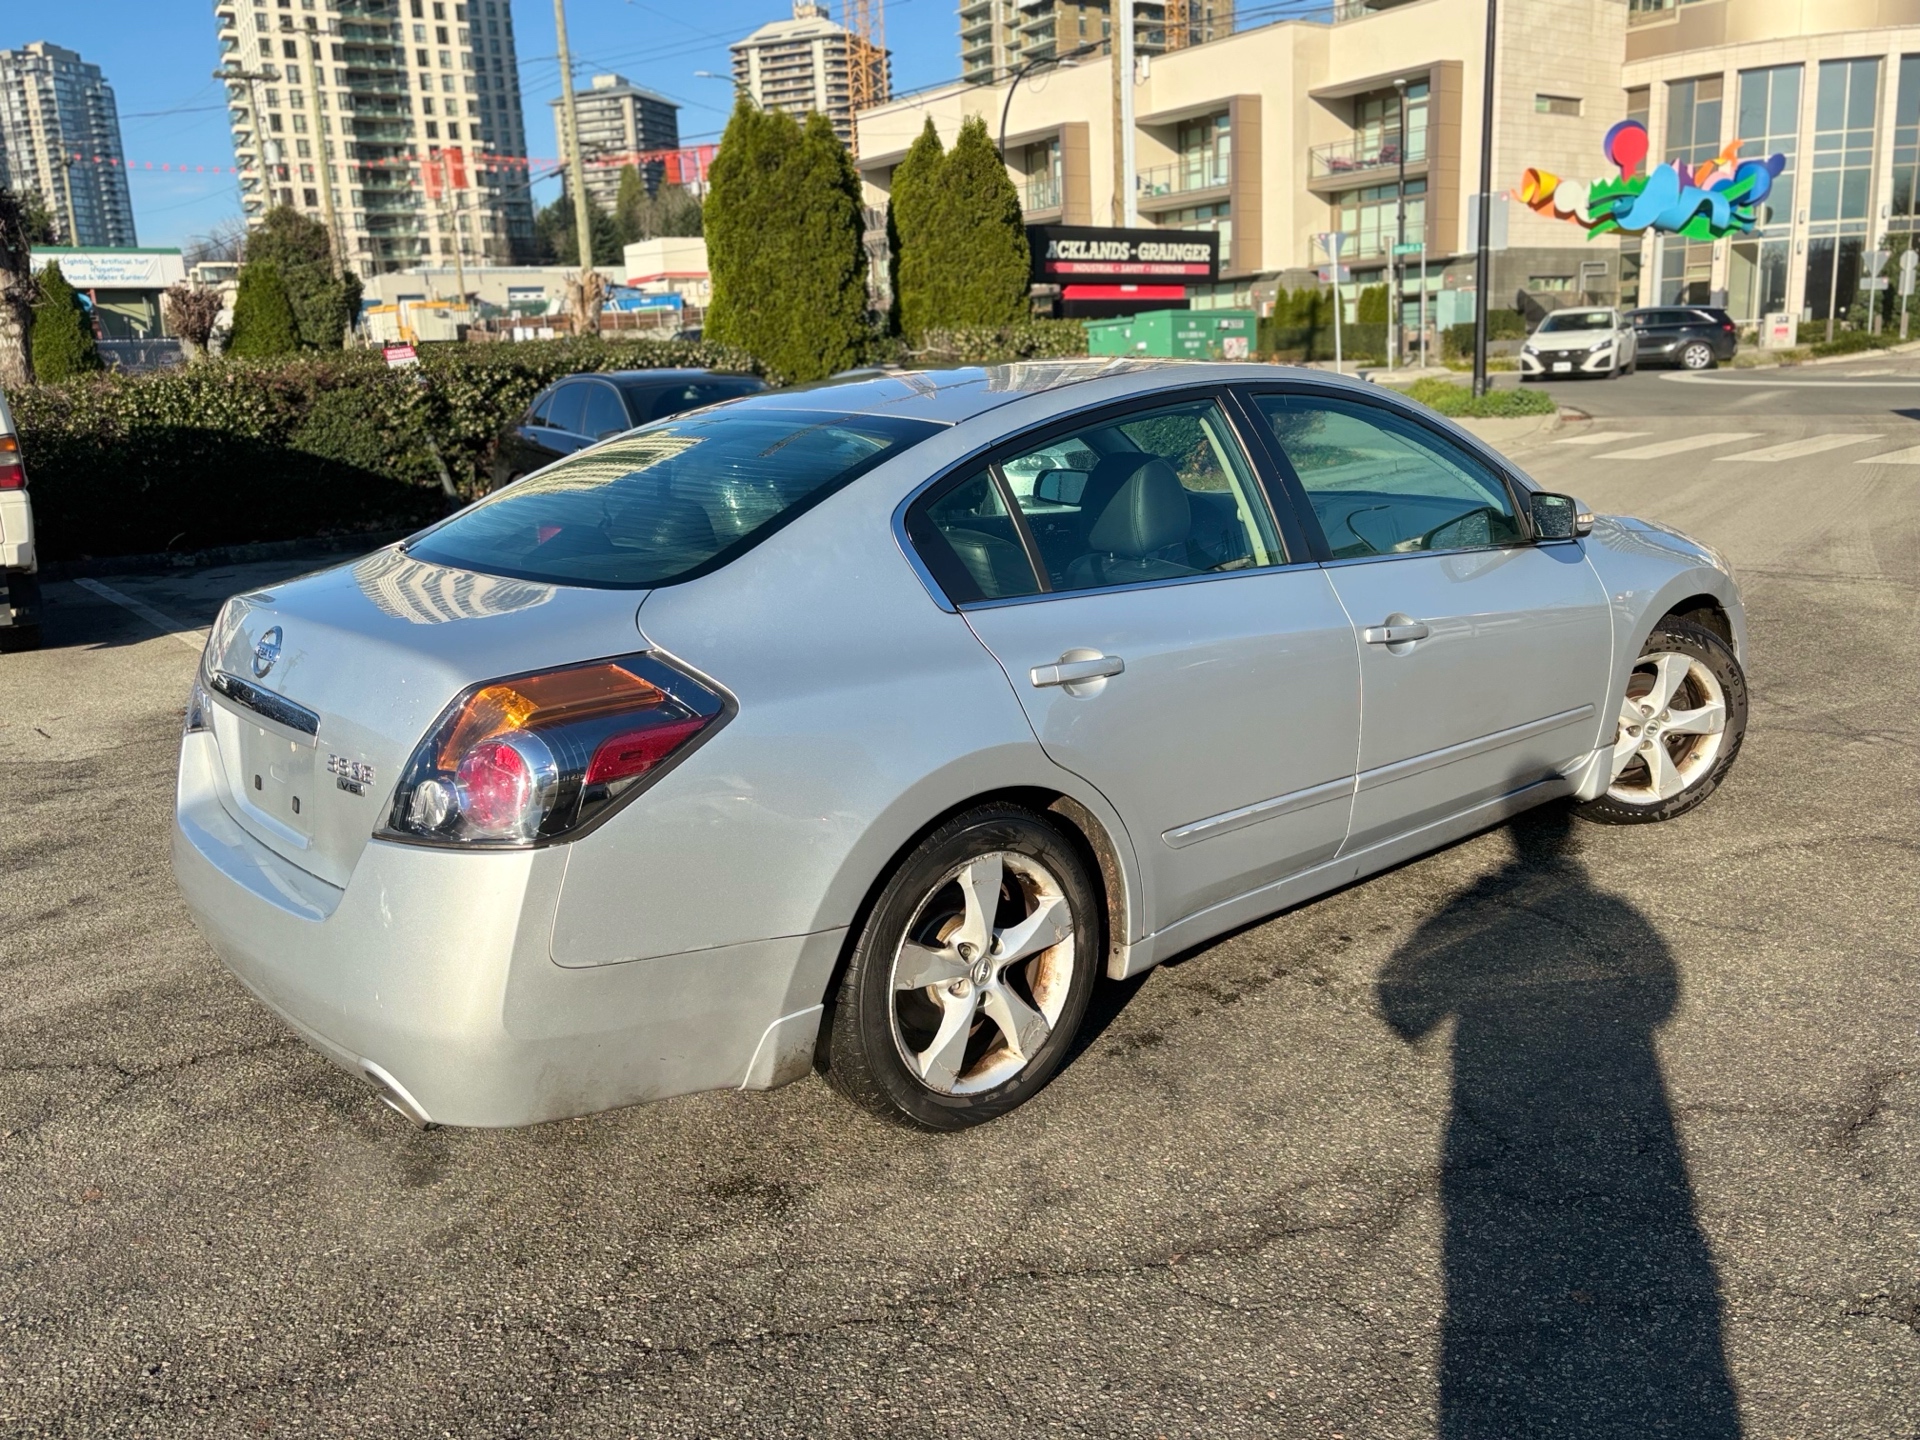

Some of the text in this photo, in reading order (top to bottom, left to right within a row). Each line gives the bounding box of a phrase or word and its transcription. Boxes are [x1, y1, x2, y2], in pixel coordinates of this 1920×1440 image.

[1046, 240, 1211, 262] ACKLANDS-GRAINGER
[63, 258, 94, 267] Lighting
[1072, 262, 1114, 273] INDUSTRIAL
[1120, 263, 1144, 274] SAFETY
[340, 779, 359, 793] V6
